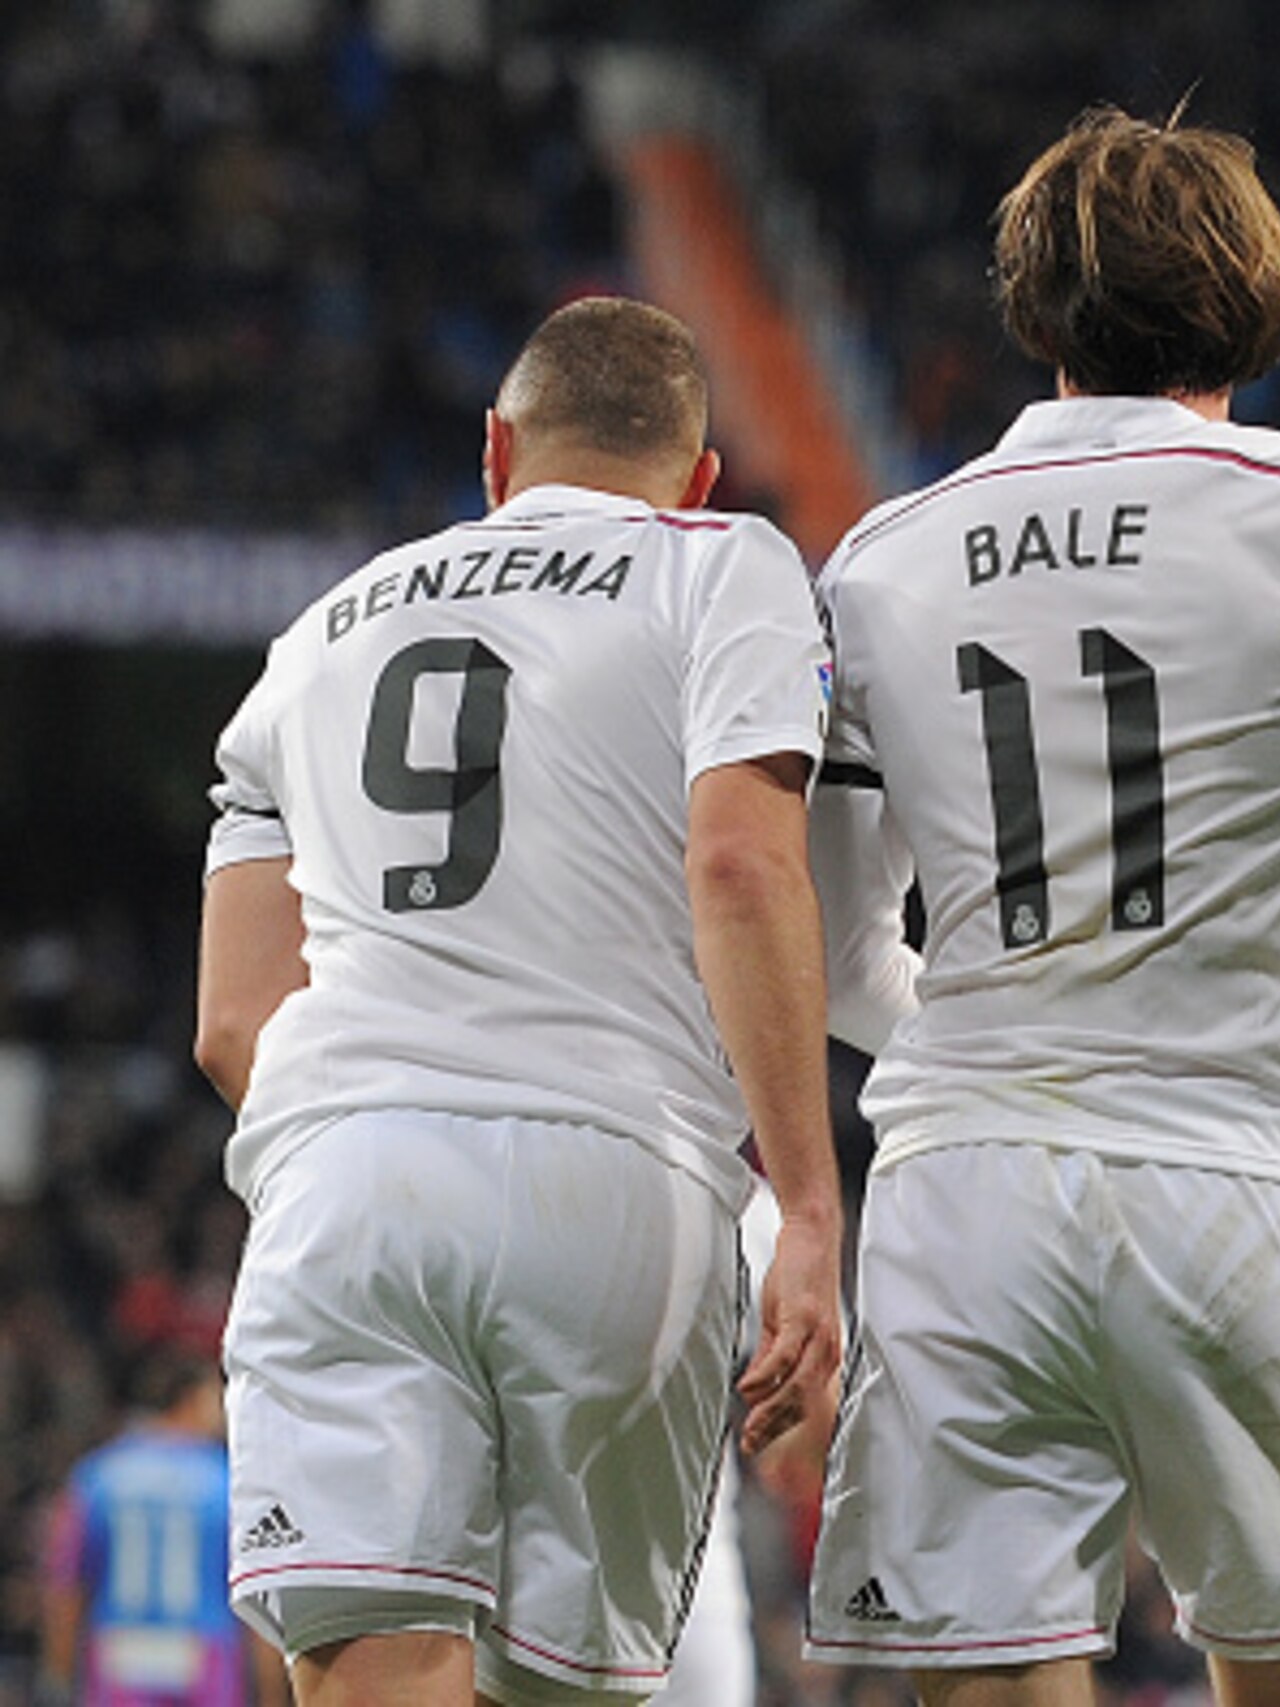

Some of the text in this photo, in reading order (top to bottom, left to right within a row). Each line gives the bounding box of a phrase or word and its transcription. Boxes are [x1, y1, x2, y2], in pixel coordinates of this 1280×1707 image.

[326, 548, 633, 644] BENZEMA
[965, 504, 1149, 587] BALE
[361, 637, 514, 914] 9
[956, 628, 1164, 949] 11
